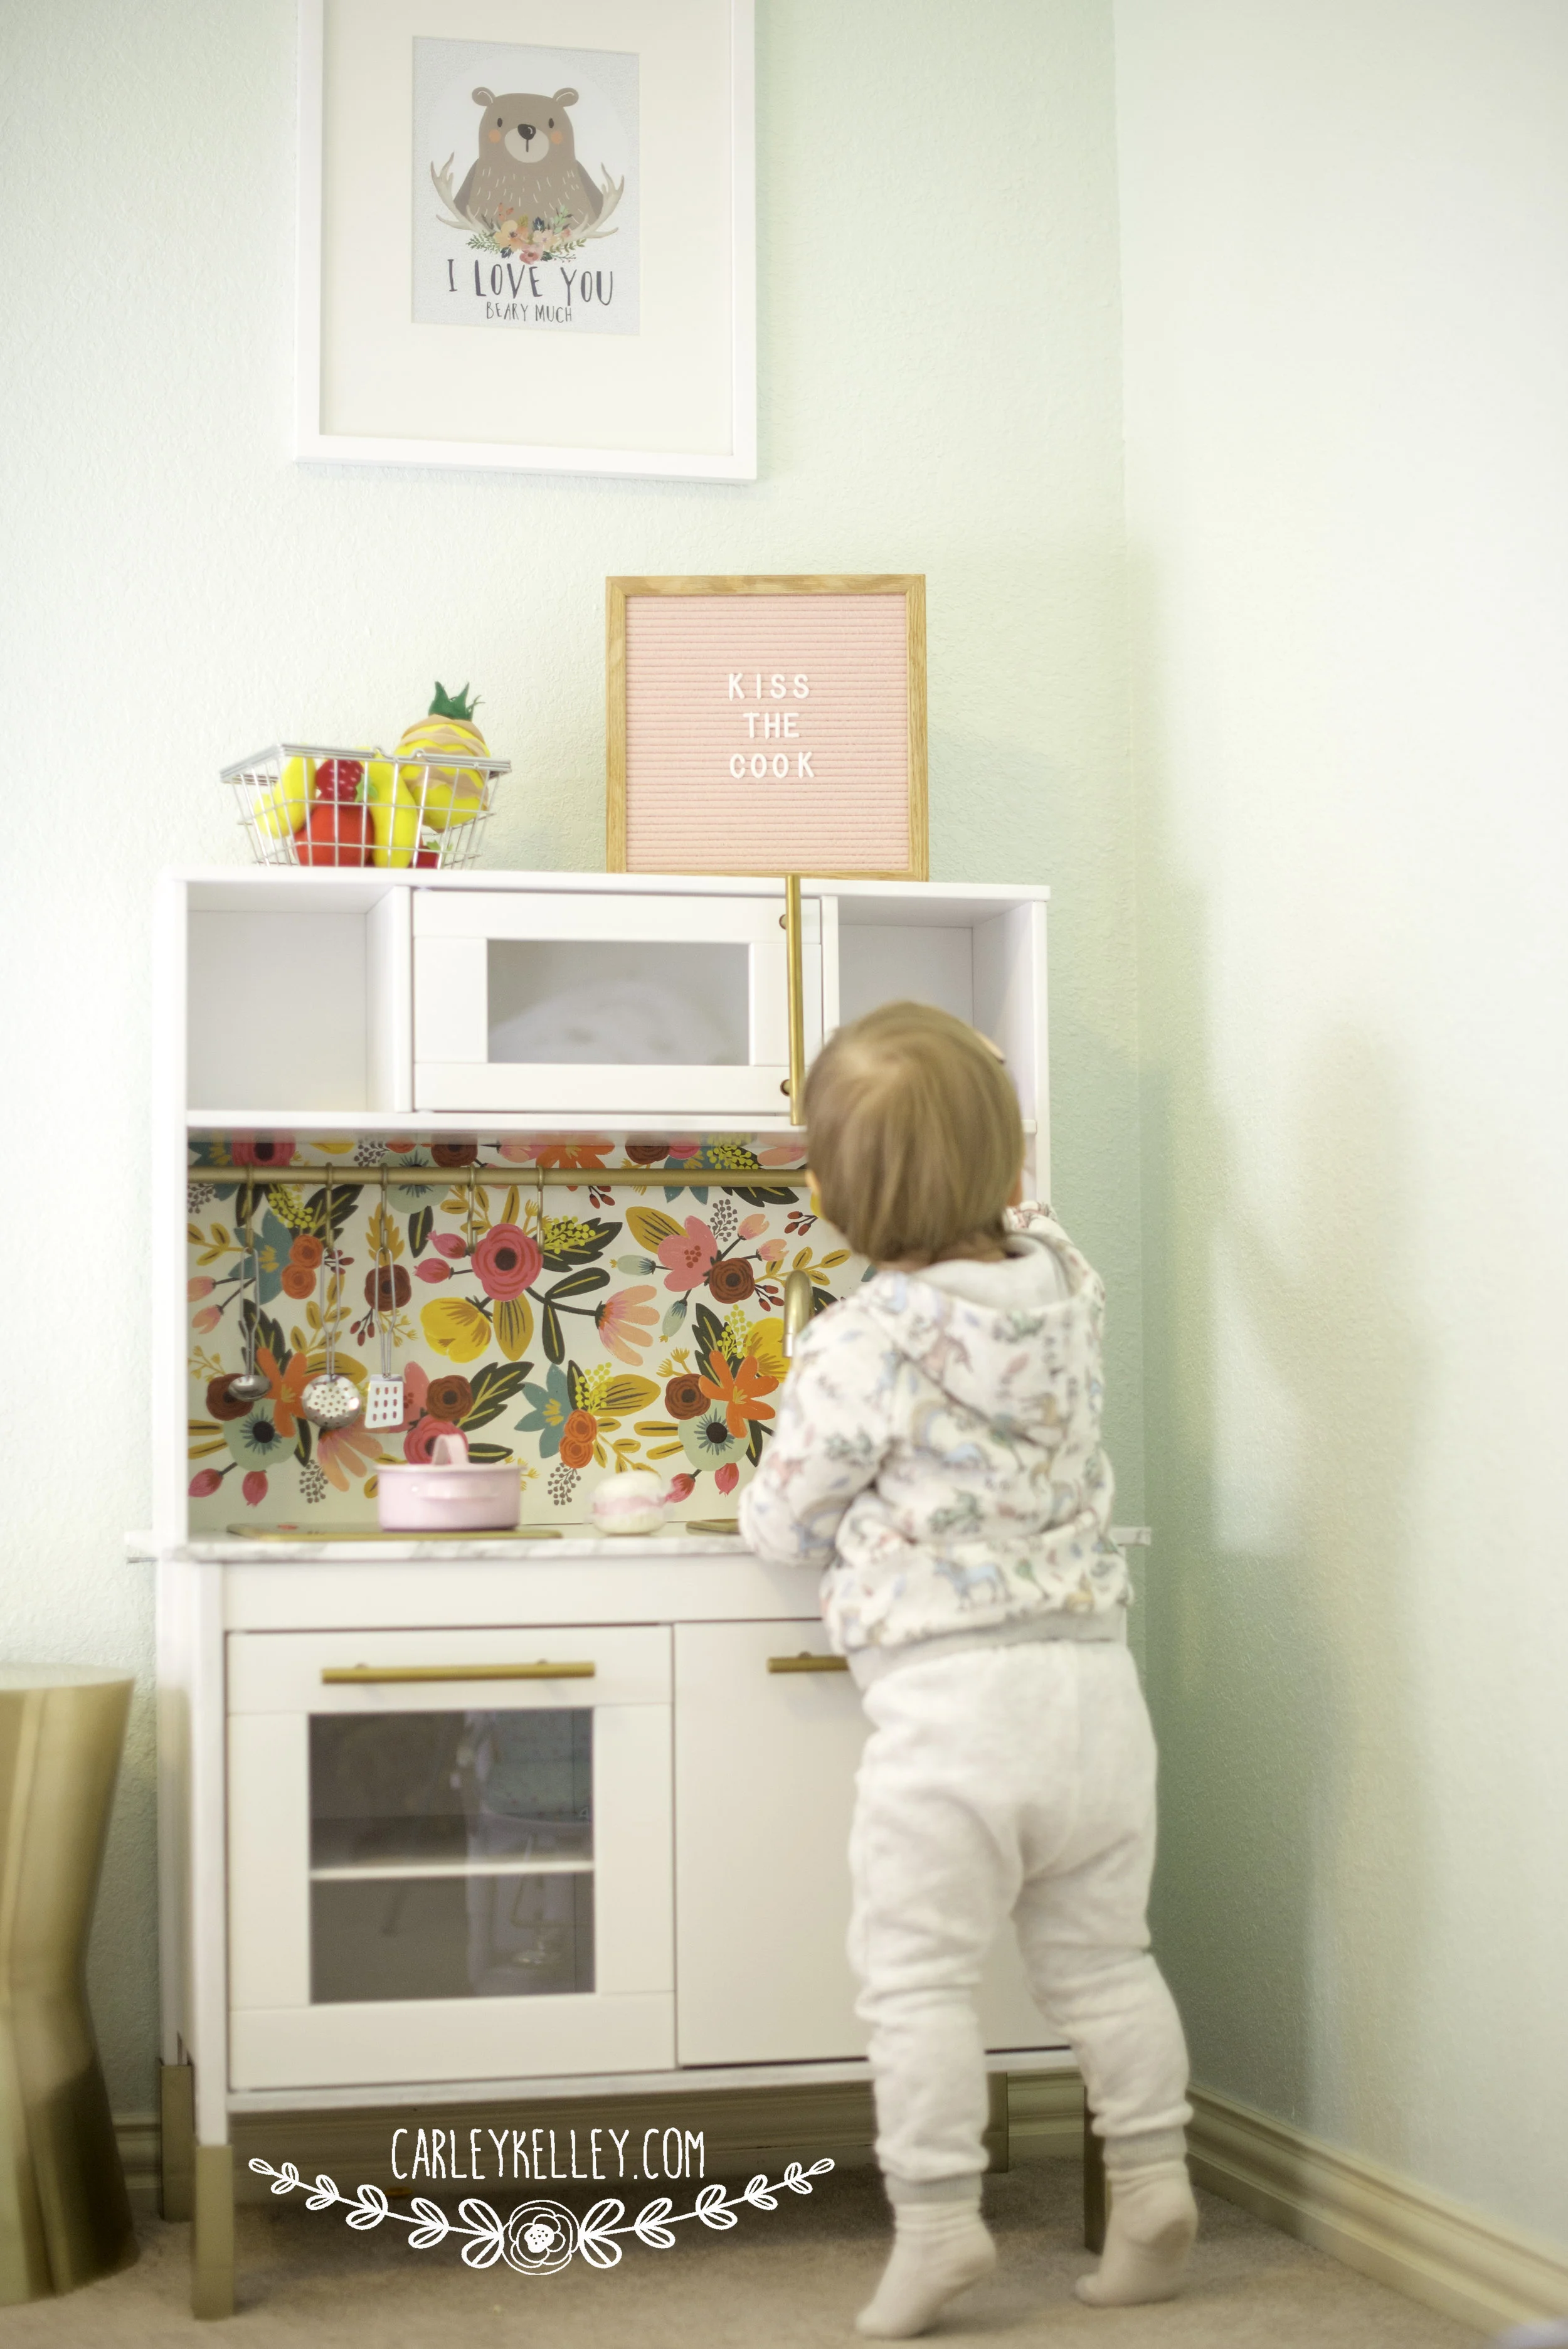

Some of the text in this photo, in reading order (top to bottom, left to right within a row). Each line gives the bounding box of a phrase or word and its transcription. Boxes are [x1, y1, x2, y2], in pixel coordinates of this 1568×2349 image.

[447, 259, 613, 306] I LOVE YOU
[486, 301, 572, 323] BEARY MUCH
[729, 673, 810, 701] KISS
[743, 713, 800, 740] THE
[729, 752, 815, 779] COOK
